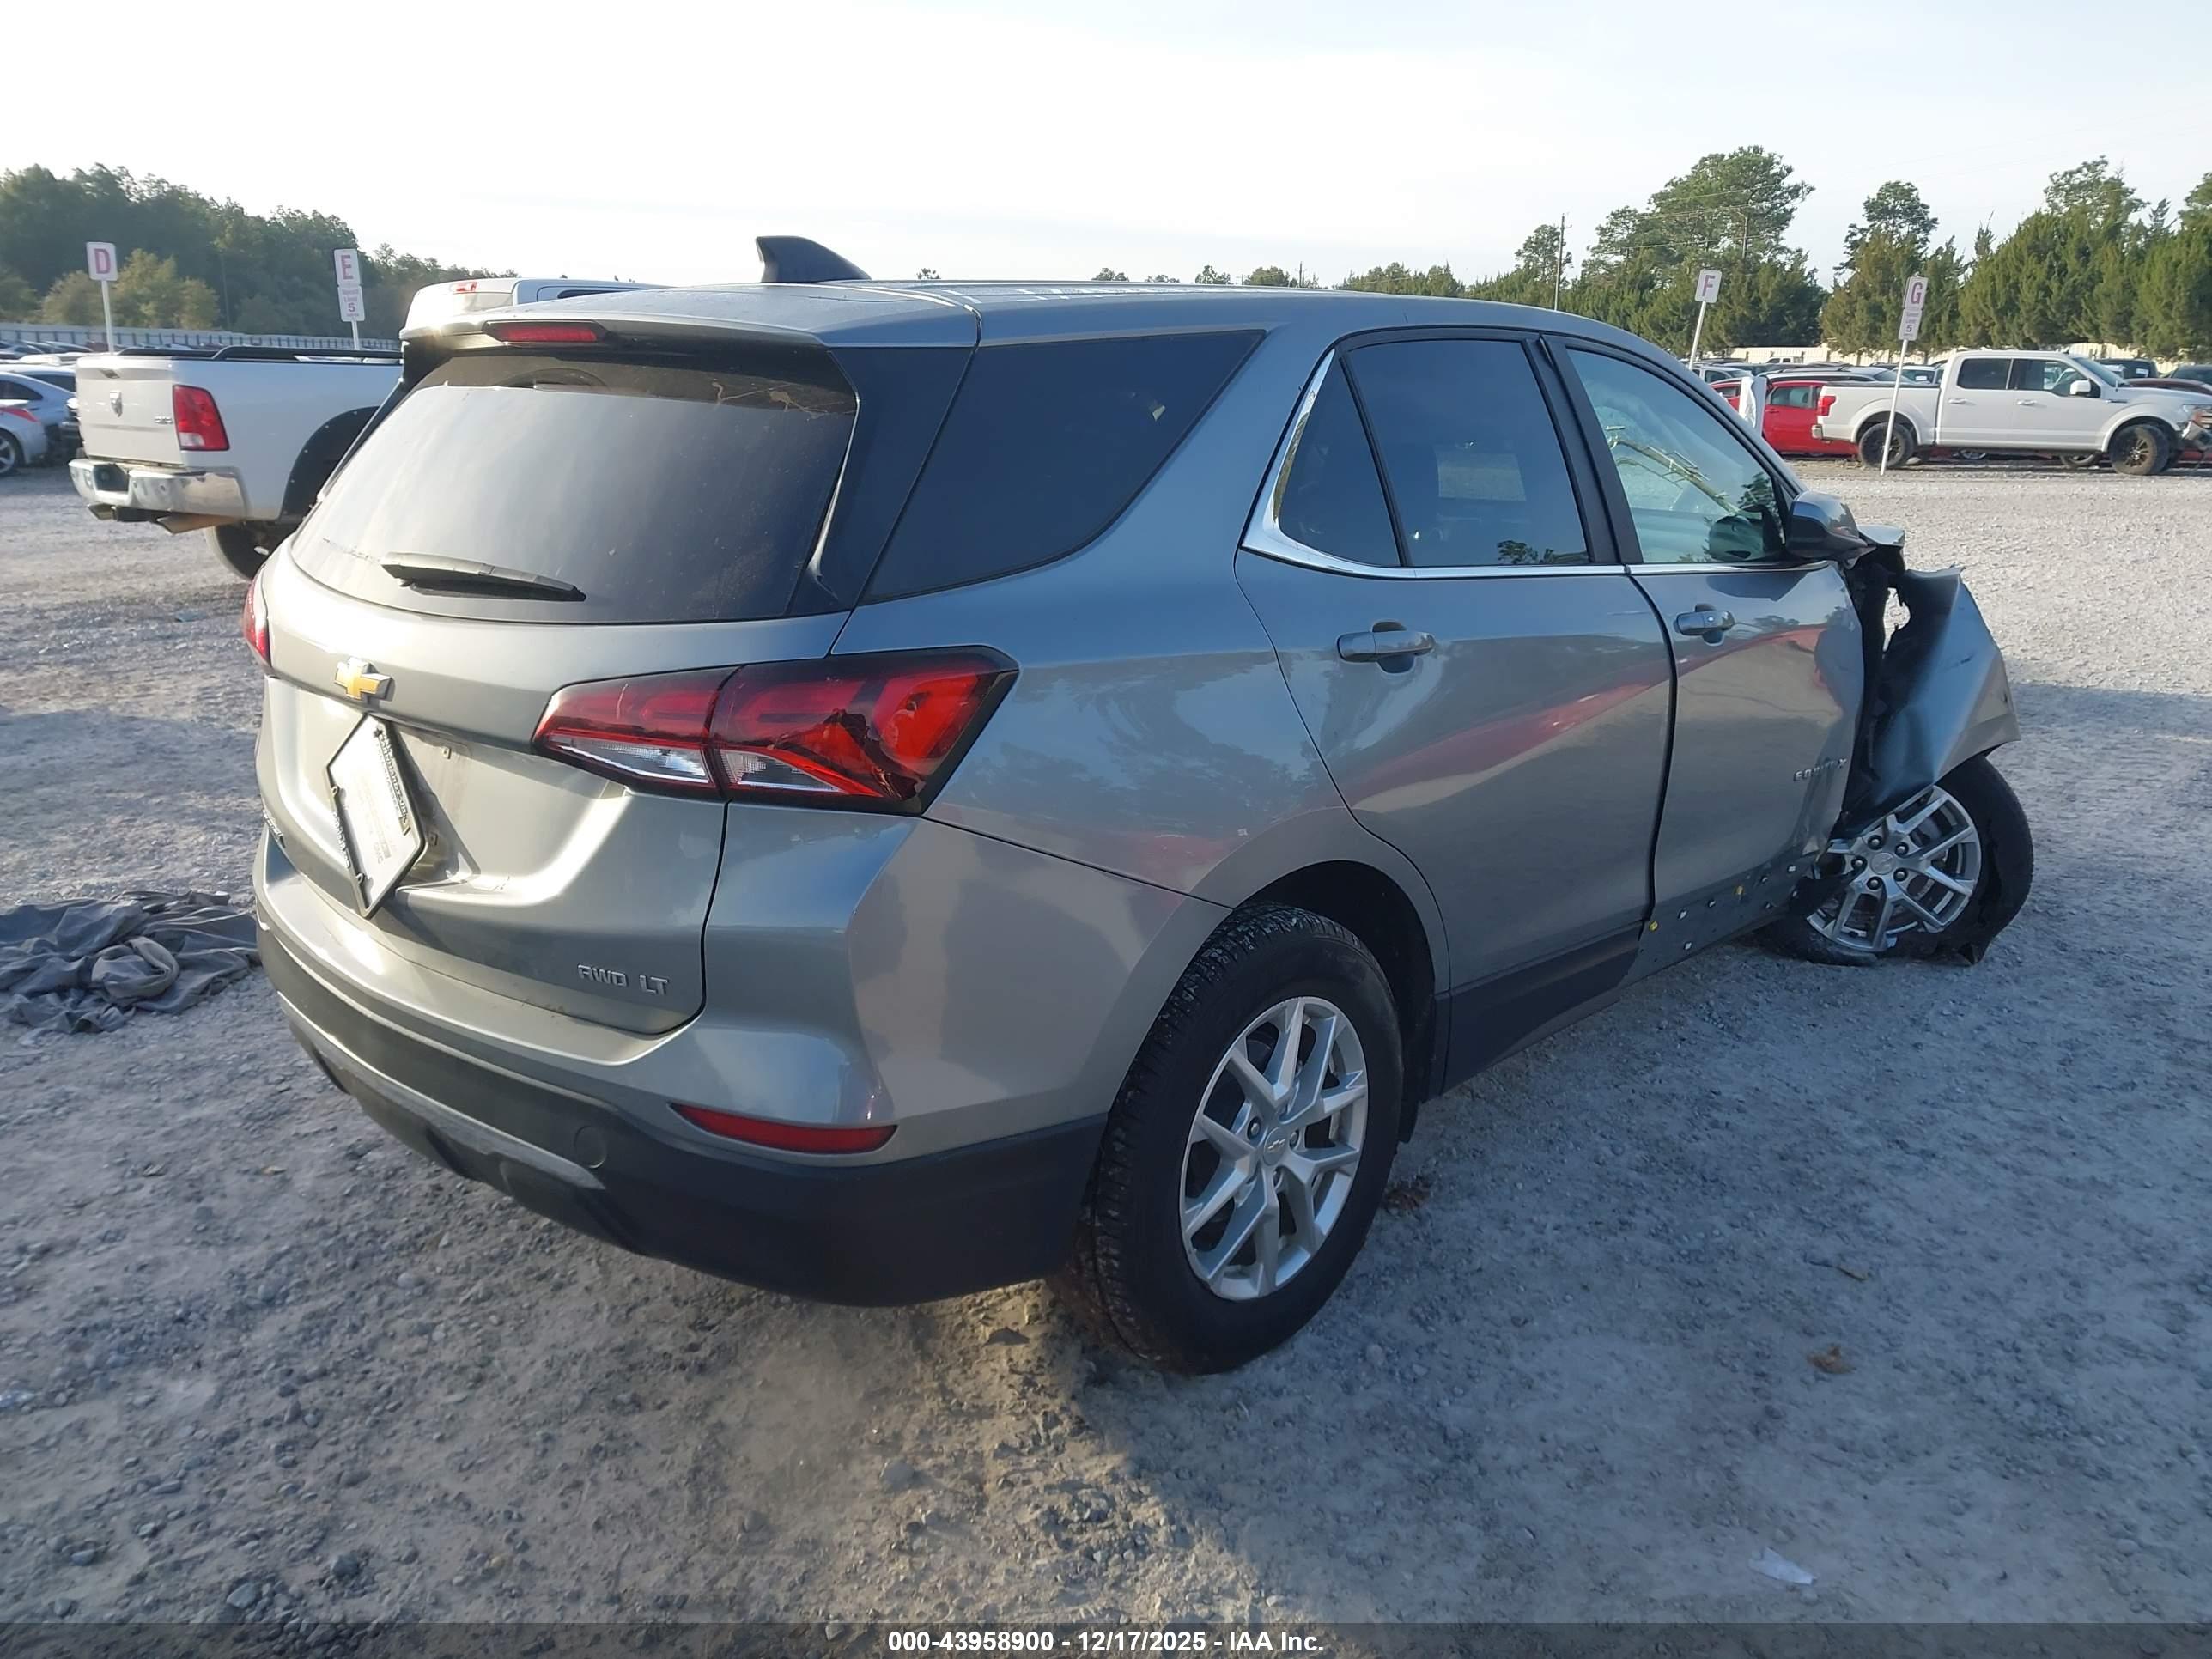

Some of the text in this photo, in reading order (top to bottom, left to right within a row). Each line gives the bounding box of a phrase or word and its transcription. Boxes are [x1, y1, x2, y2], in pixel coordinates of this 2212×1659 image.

[94, 248, 111, 274] D
[341, 254, 354, 280] E
[1702, 274, 1716, 297] F
[1911, 282, 1923, 305] G
[348, 302, 356, 313] 5
[1906, 324, 1913, 333] 5
[577, 963, 669, 996] AWD LT
